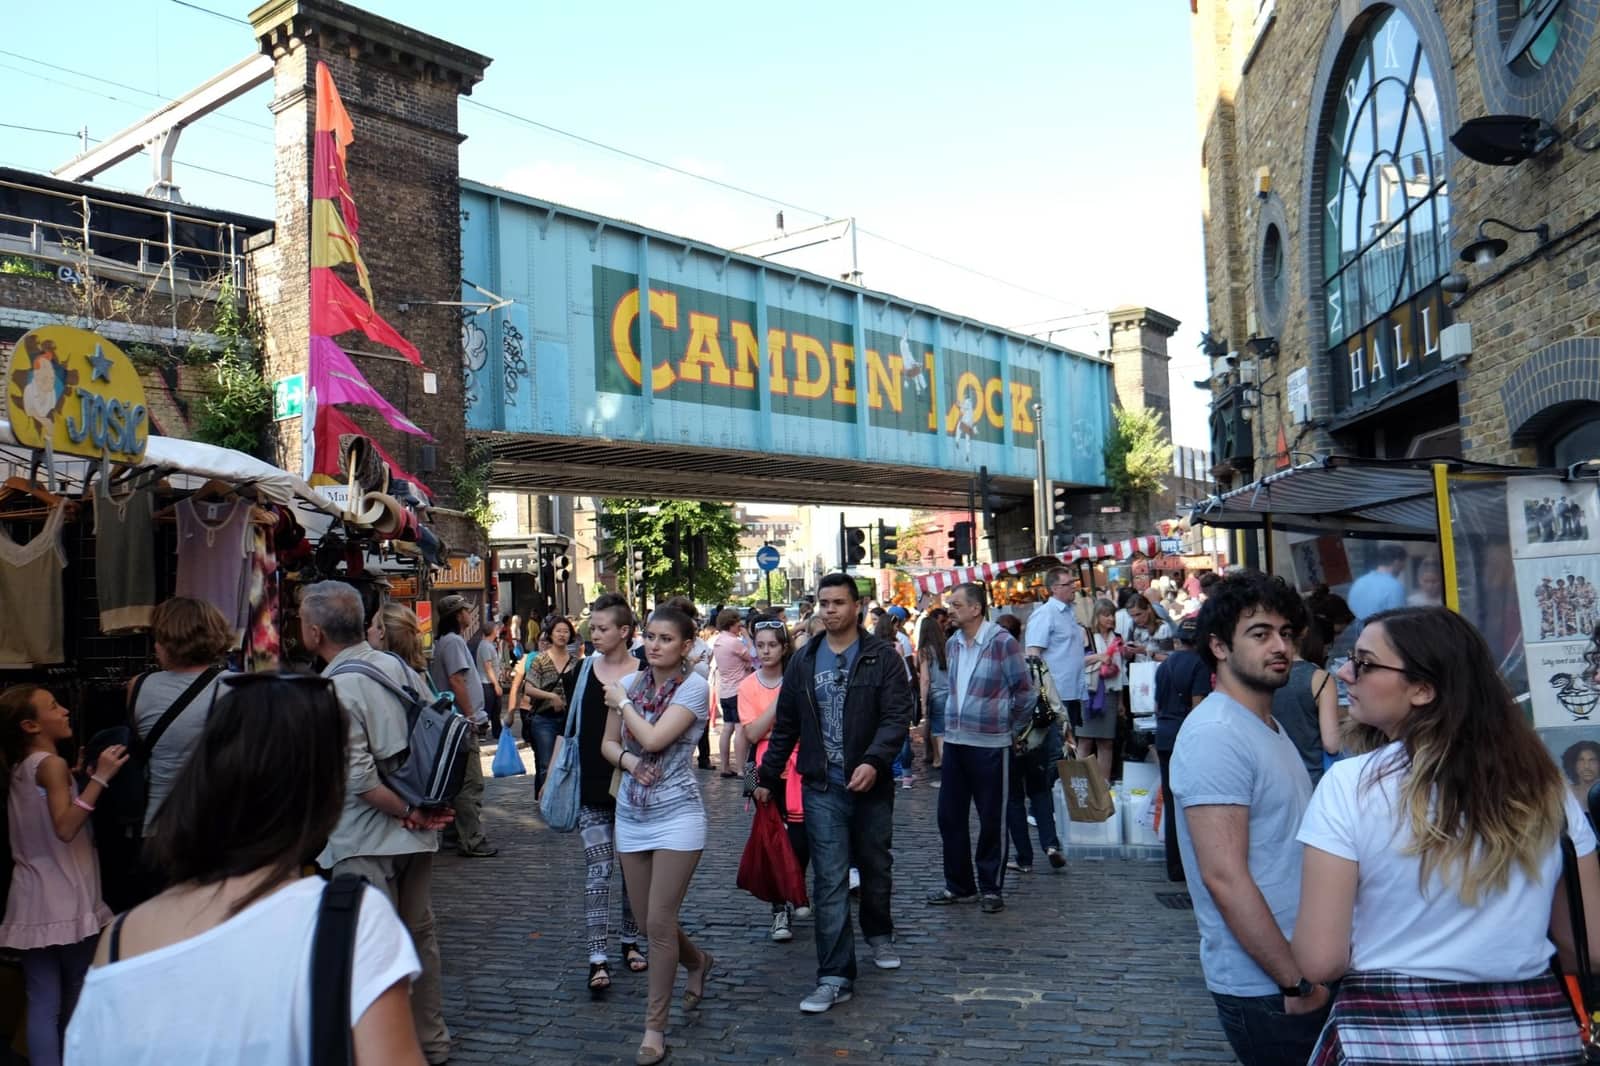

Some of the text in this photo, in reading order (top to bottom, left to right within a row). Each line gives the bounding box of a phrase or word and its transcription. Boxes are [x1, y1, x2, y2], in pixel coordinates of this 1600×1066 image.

[611, 288, 904, 412] CAMDEN
[924, 351, 1034, 434] LOCK
[1350, 307, 1439, 392] HALL
[499, 558, 524, 570] EYE
